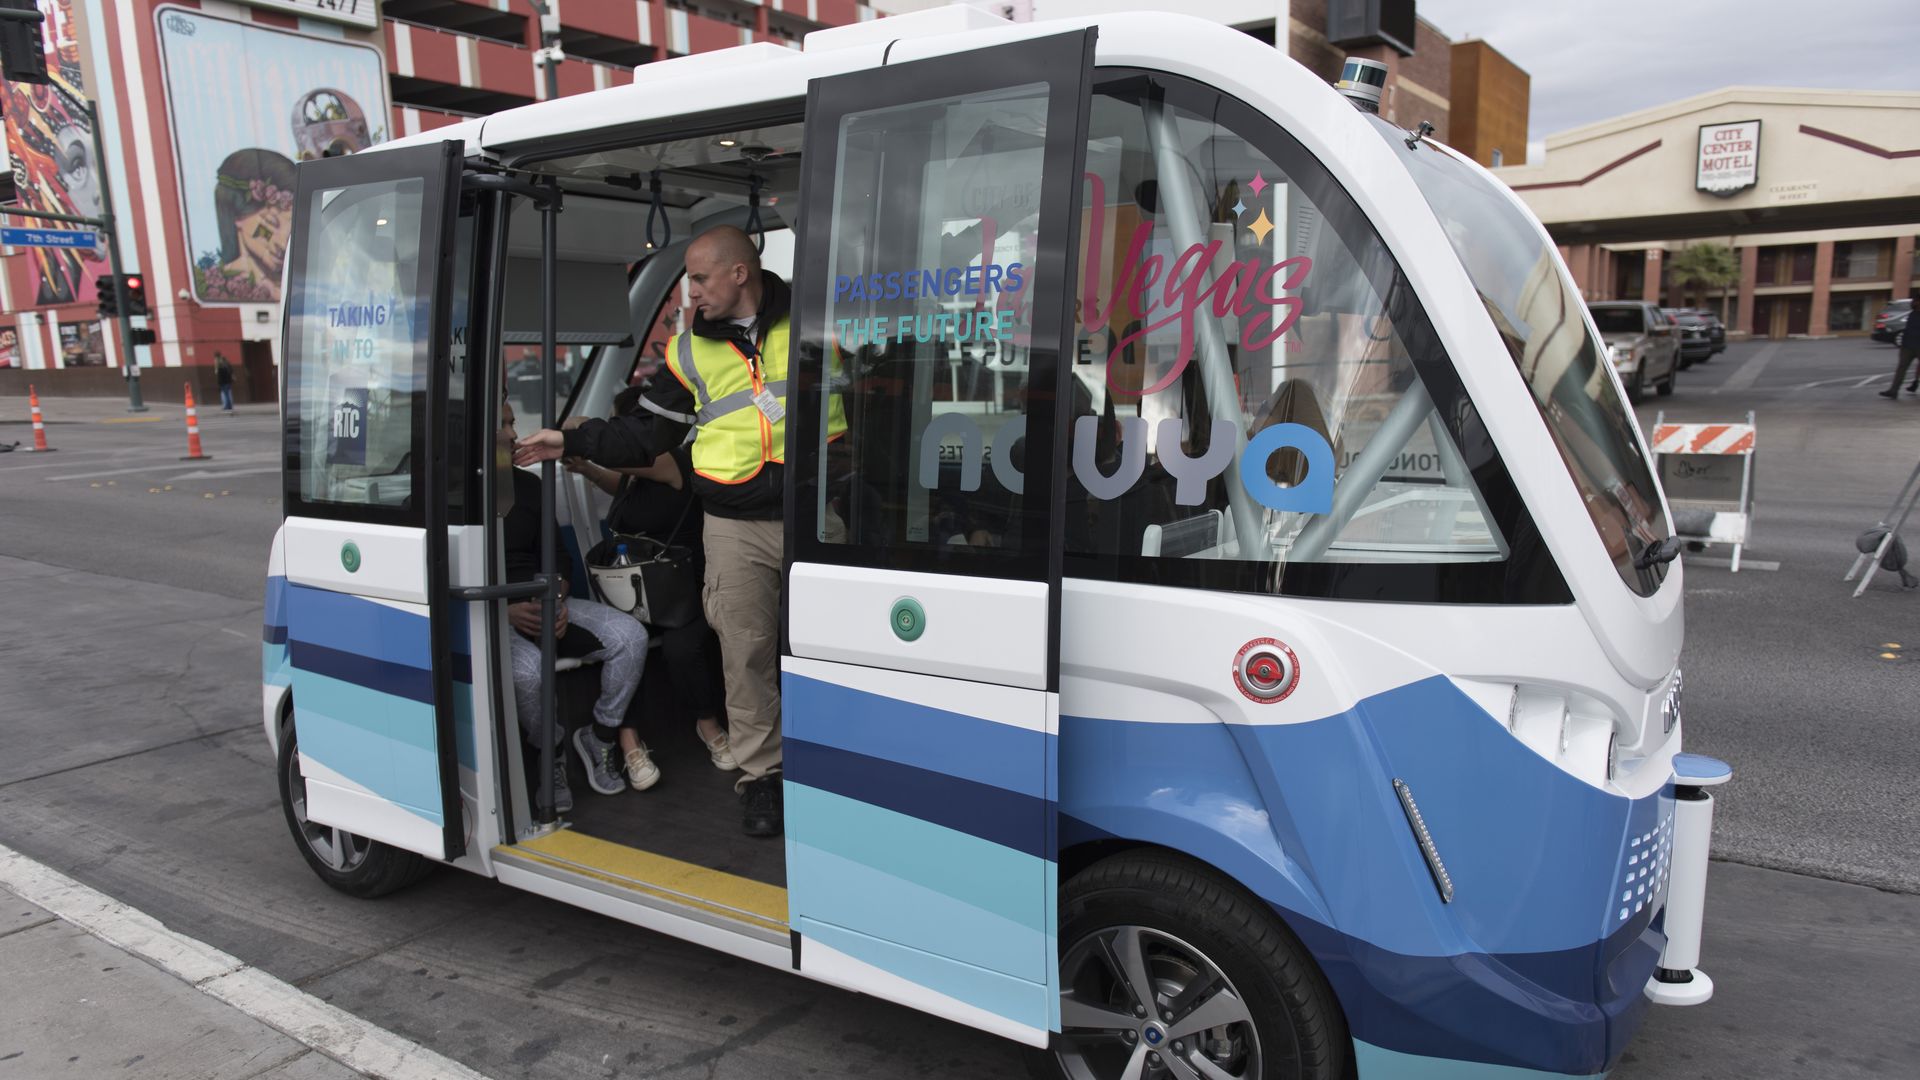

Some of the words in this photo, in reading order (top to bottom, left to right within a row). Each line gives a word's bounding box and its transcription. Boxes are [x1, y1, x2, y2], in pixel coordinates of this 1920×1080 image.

[1715, 129, 1743, 141] CITY
[1703, 141, 1752, 155] CENTER
[1702, 155, 1752, 171] MOTEL
[25, 233, 43, 243] 7th
[45, 234, 74, 244] Street
[834, 262, 1024, 304] PASSENGERS
[1084, 172, 1312, 395] Vegas
[329, 305, 385, 328] TAKING
[836, 316, 889, 346] THE
[897, 310, 1015, 344] FUTURE
[334, 339, 350, 360] IN
[354, 338, 373, 358] TO
[333, 407, 359, 438] RTC
